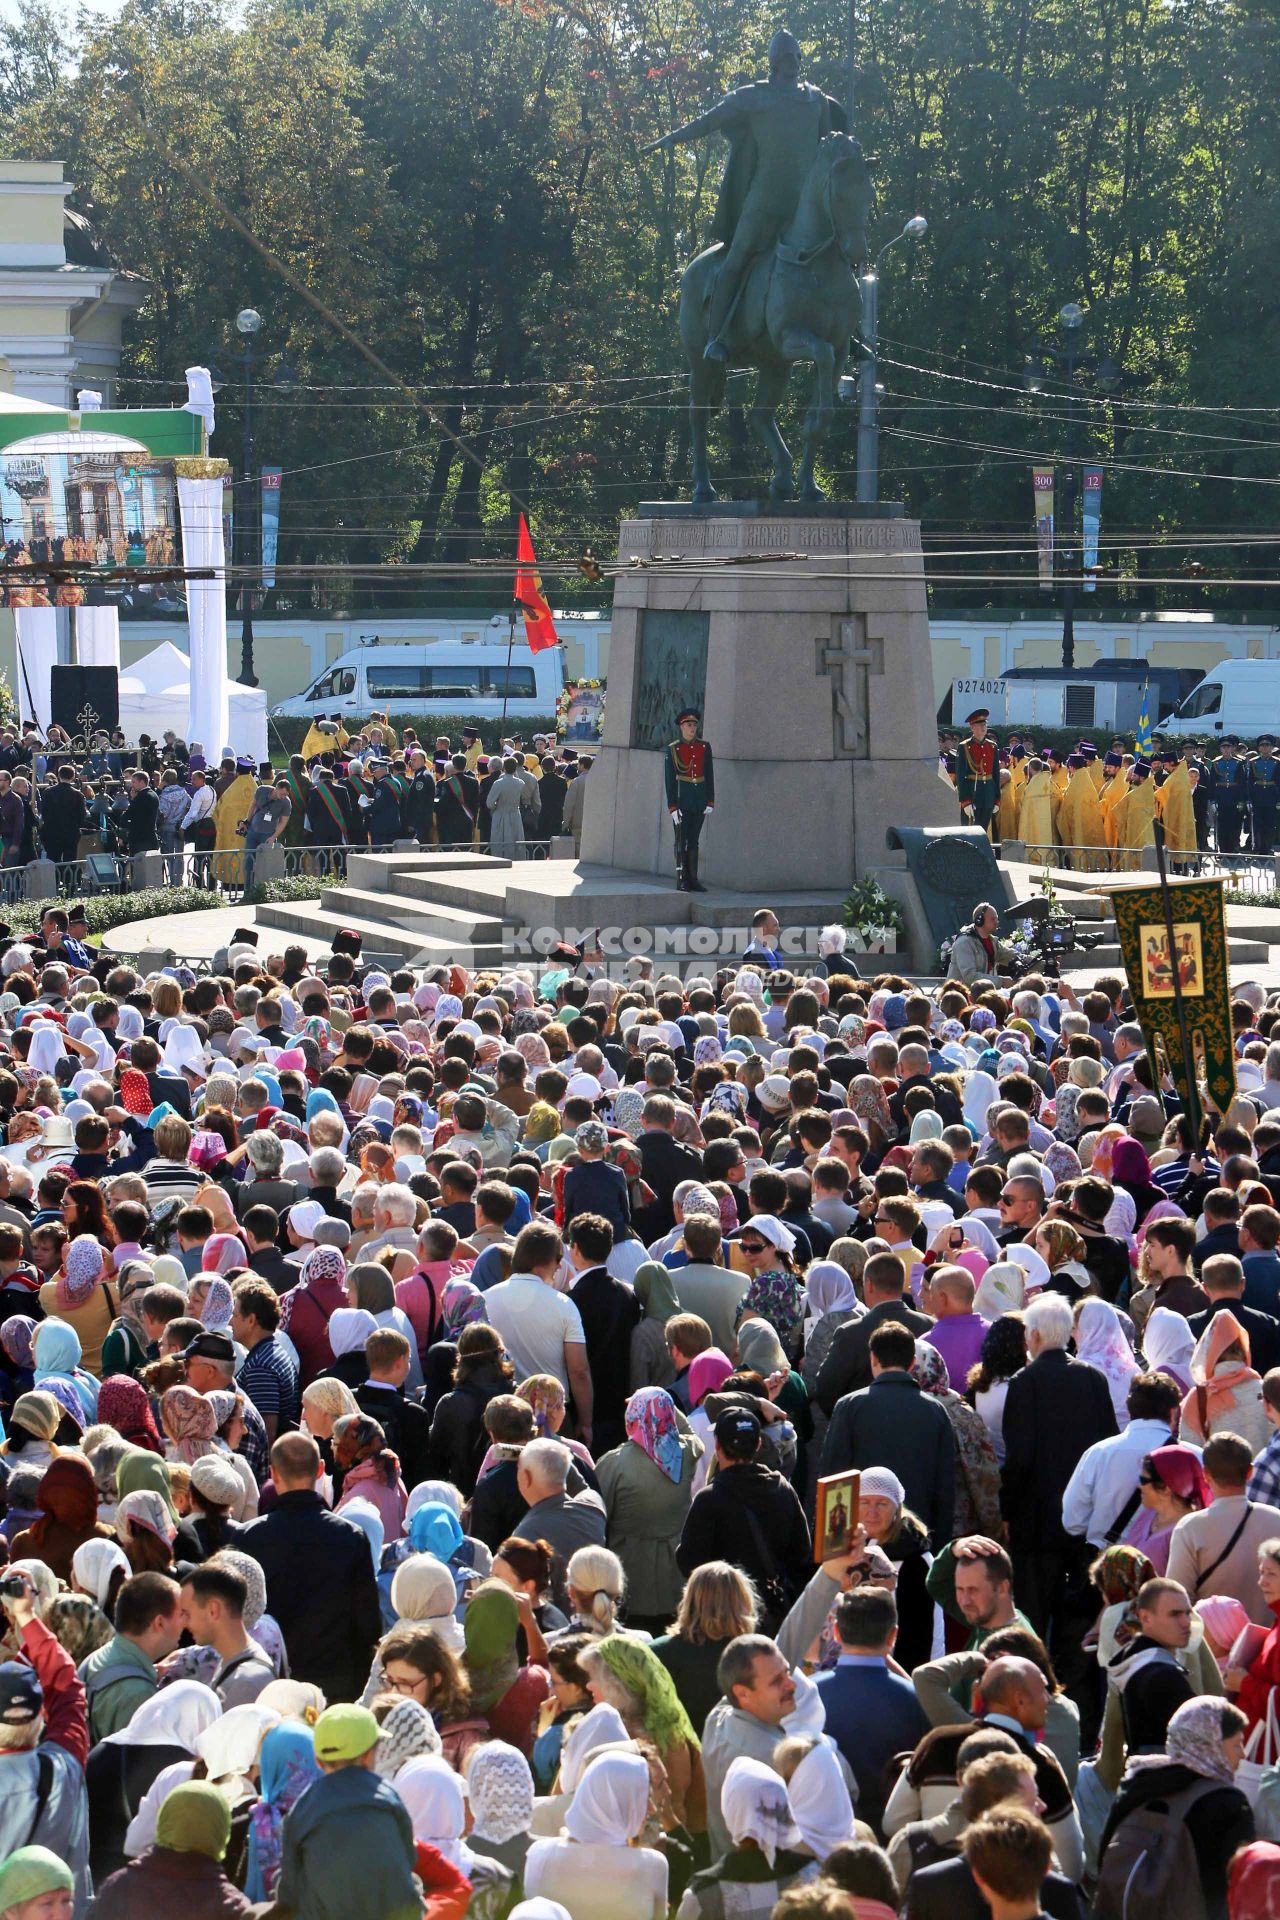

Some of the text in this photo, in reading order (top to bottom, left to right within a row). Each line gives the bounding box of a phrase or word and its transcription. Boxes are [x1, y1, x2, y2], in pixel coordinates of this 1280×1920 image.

[267, 475, 278, 486] 12
[1034, 476, 1053, 486] 300
[1087, 476, 1099, 486] 12
[957, 680, 1006, 695] 9274027
